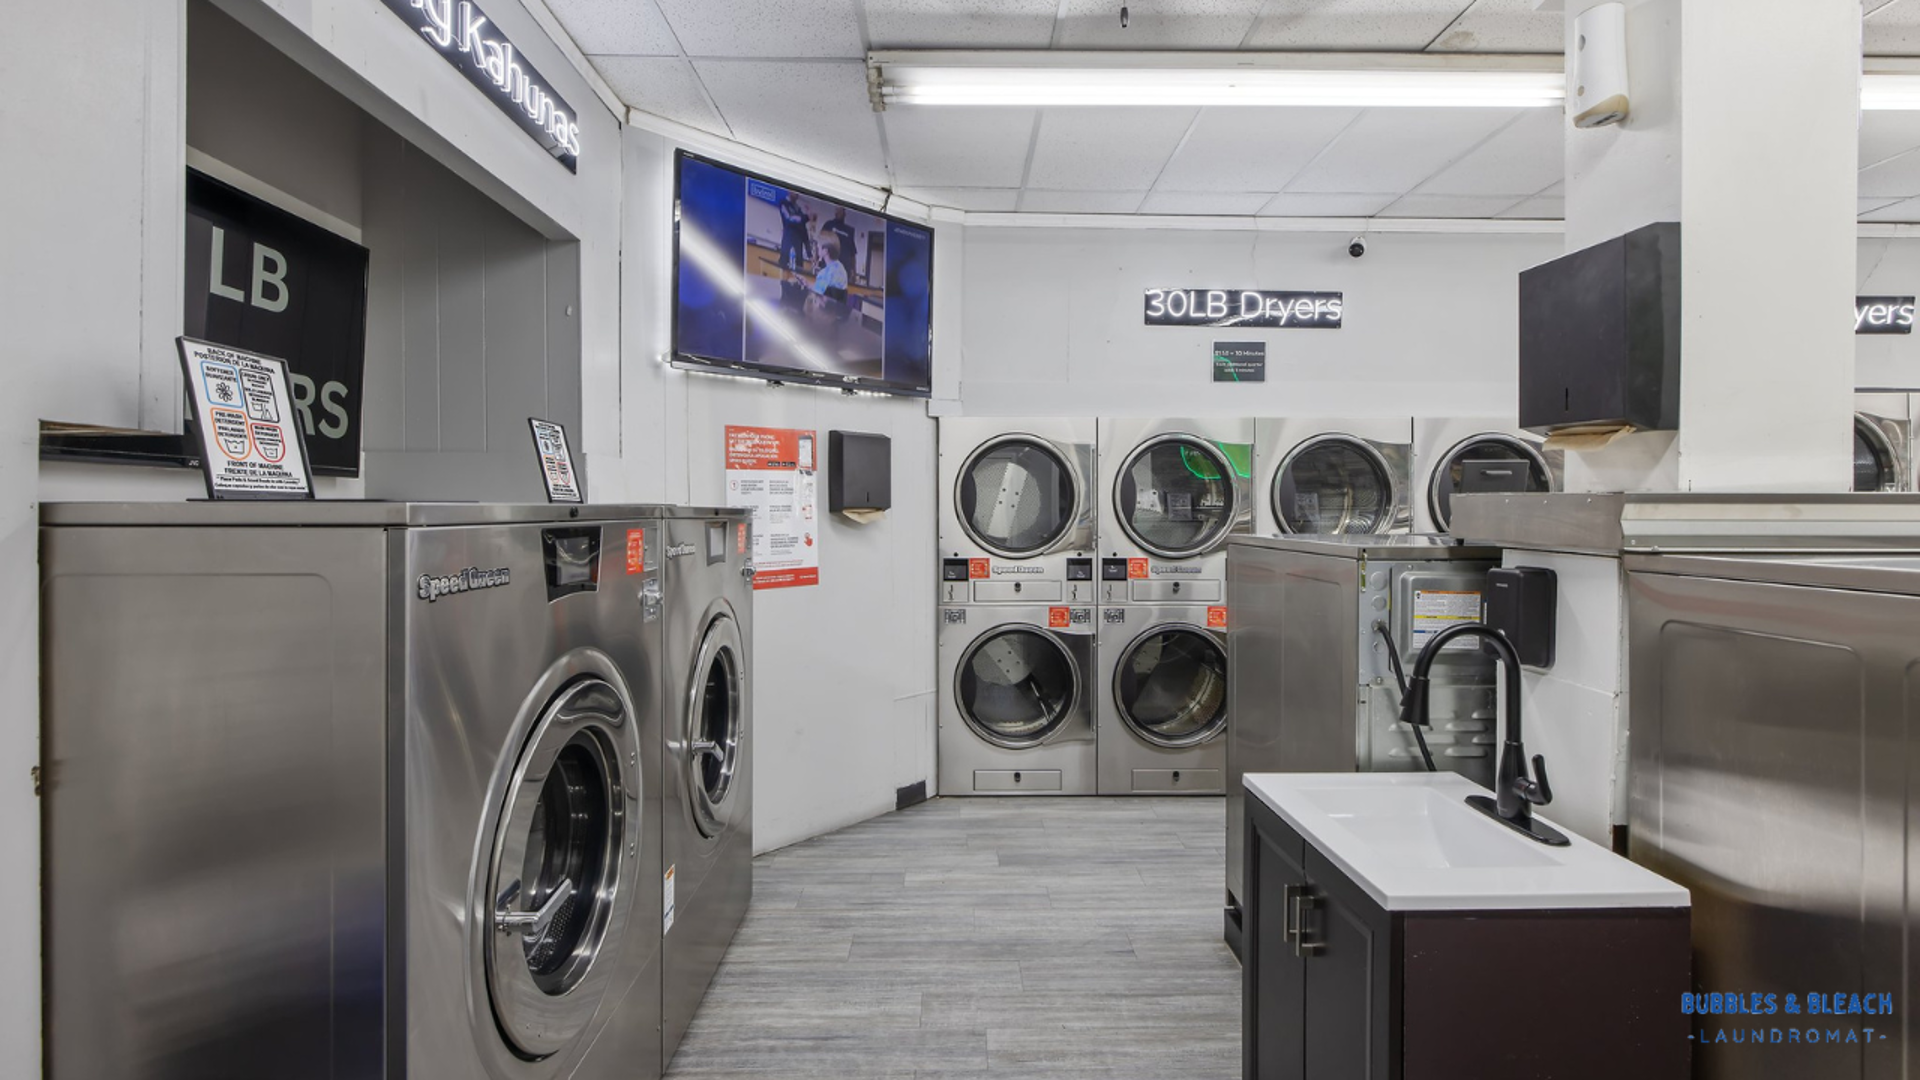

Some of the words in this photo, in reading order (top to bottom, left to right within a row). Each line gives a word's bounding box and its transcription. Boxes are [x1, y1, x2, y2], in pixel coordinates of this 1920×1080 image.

[459, 1, 580, 156] Kahunas
[210, 226, 290, 313] LB
[1145, 289, 1228, 318] 30LB
[1241, 291, 1342, 325] Dryers
[1854, 304, 1914, 331] yers
[417, 568, 469, 603] Speed
[468, 566, 510, 590] Queen
